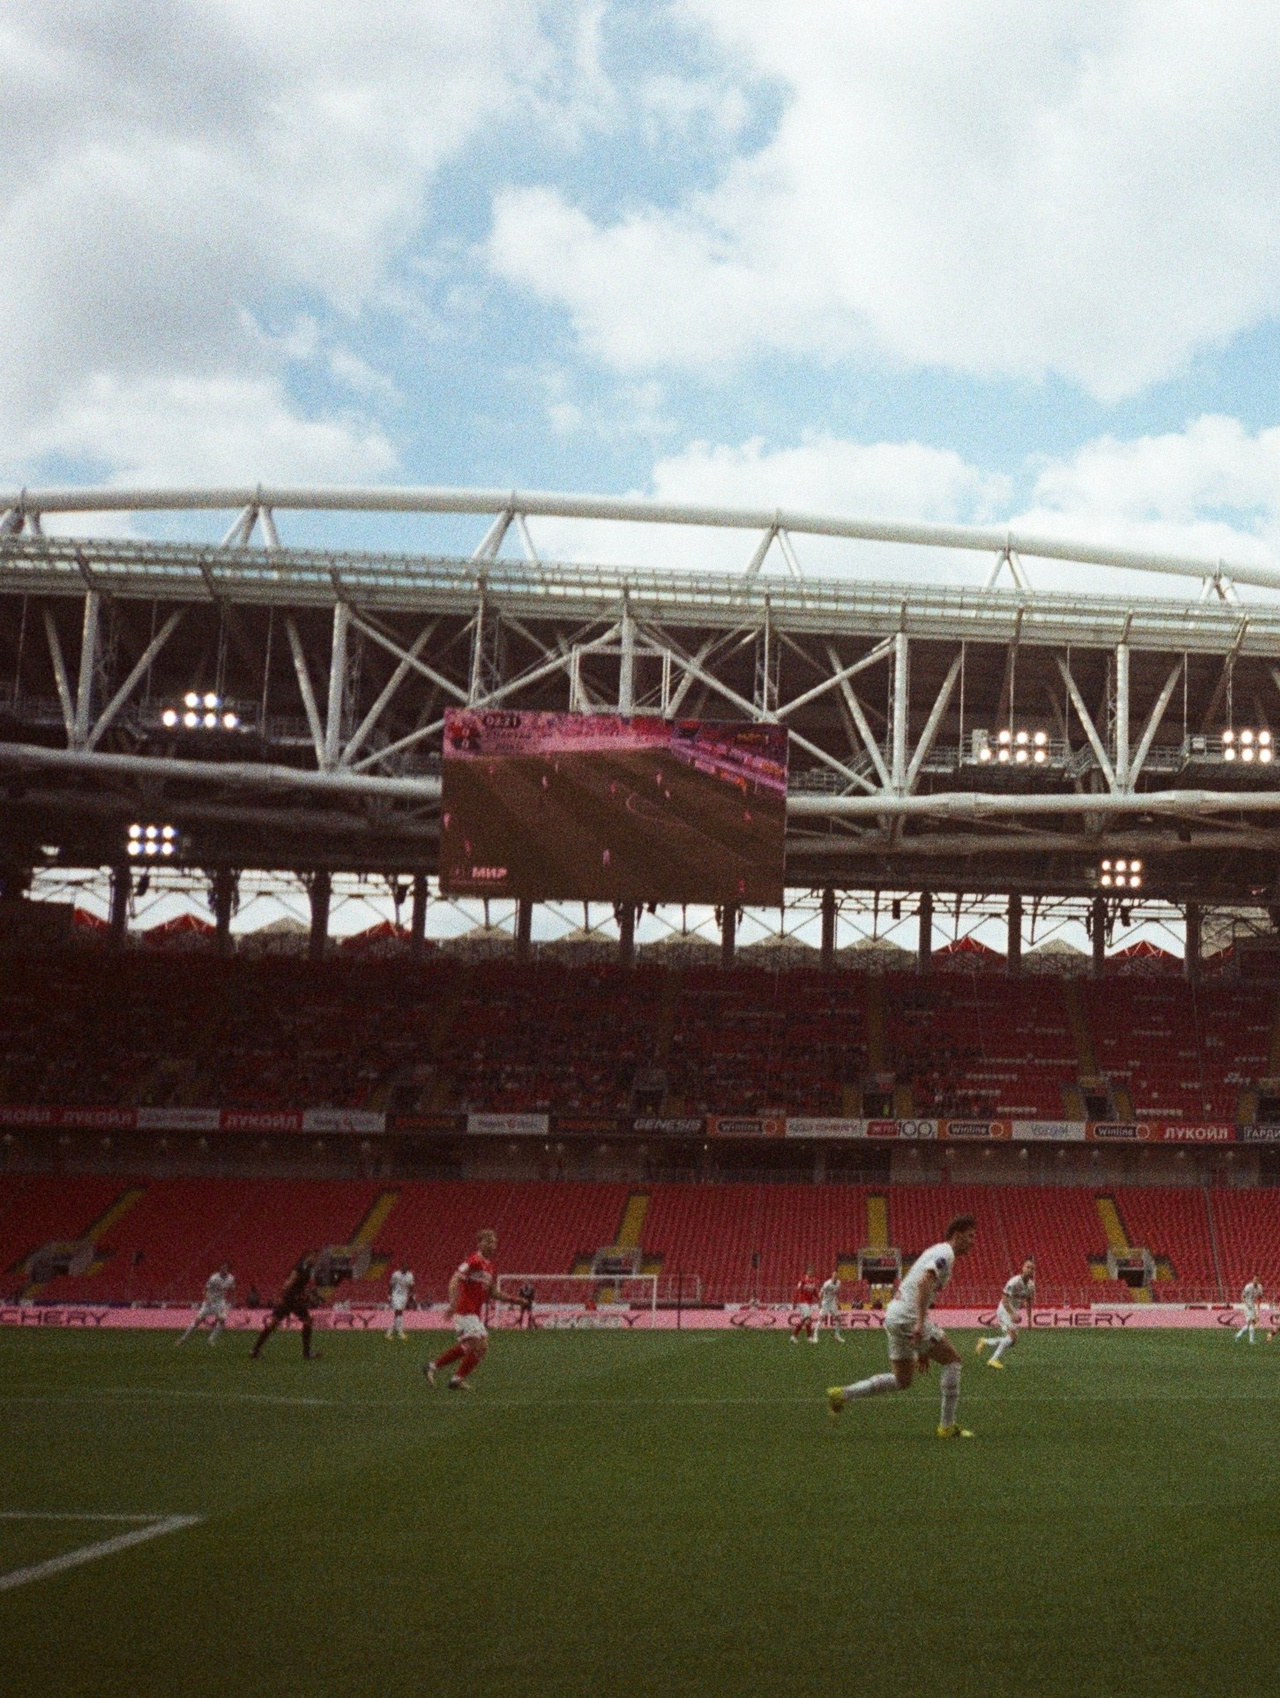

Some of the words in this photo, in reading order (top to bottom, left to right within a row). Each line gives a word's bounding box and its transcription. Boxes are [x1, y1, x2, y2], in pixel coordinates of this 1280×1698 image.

[225, 1112, 299, 1128] ЛУКОЙЛ
[1164, 1125, 1228, 1140] ЛУКОЙЛ
[0, 1310, 108, 1325] CHERY
[1033, 1312, 1134, 1327] CHERY
